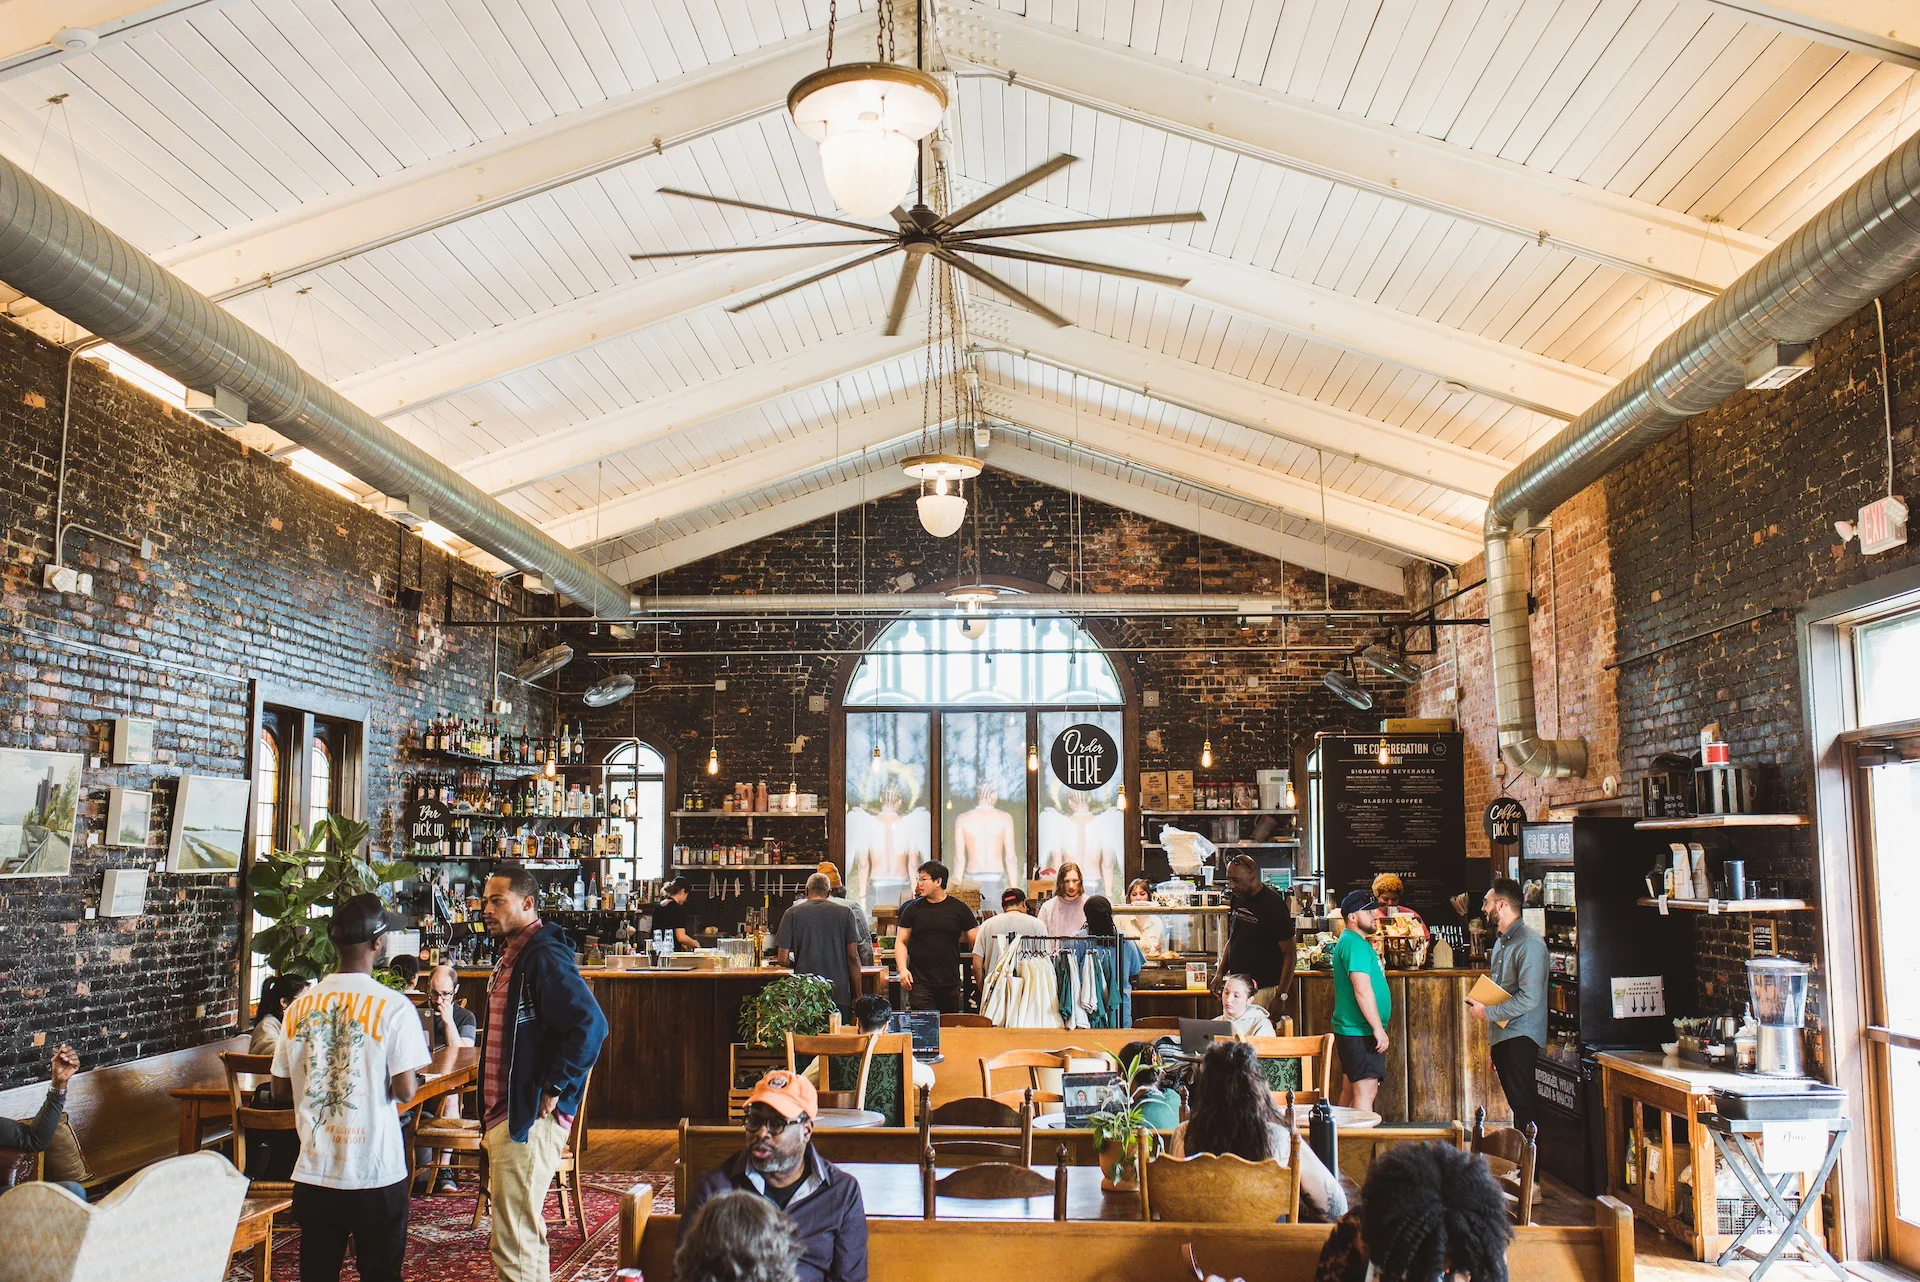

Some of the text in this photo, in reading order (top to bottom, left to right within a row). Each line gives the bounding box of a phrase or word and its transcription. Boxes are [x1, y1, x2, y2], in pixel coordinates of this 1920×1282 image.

[1863, 501, 1888, 545] EXIT
[1063, 729, 1104, 755] Order
[1353, 743, 1368, 755] THE
[1368, 743, 1429, 755] COGREGATION
[1067, 755, 1102, 784] HERE
[419, 804, 442, 821] Bar
[1489, 803, 1522, 820] Coffee
[412, 820, 445, 839] pick up
[1492, 820, 1518, 840] pick u
[1526, 832, 1570, 855] GRAZE & GO
[285, 991, 387, 1044] ORIGINAL
[325, 1123, 334, 1133] WE
